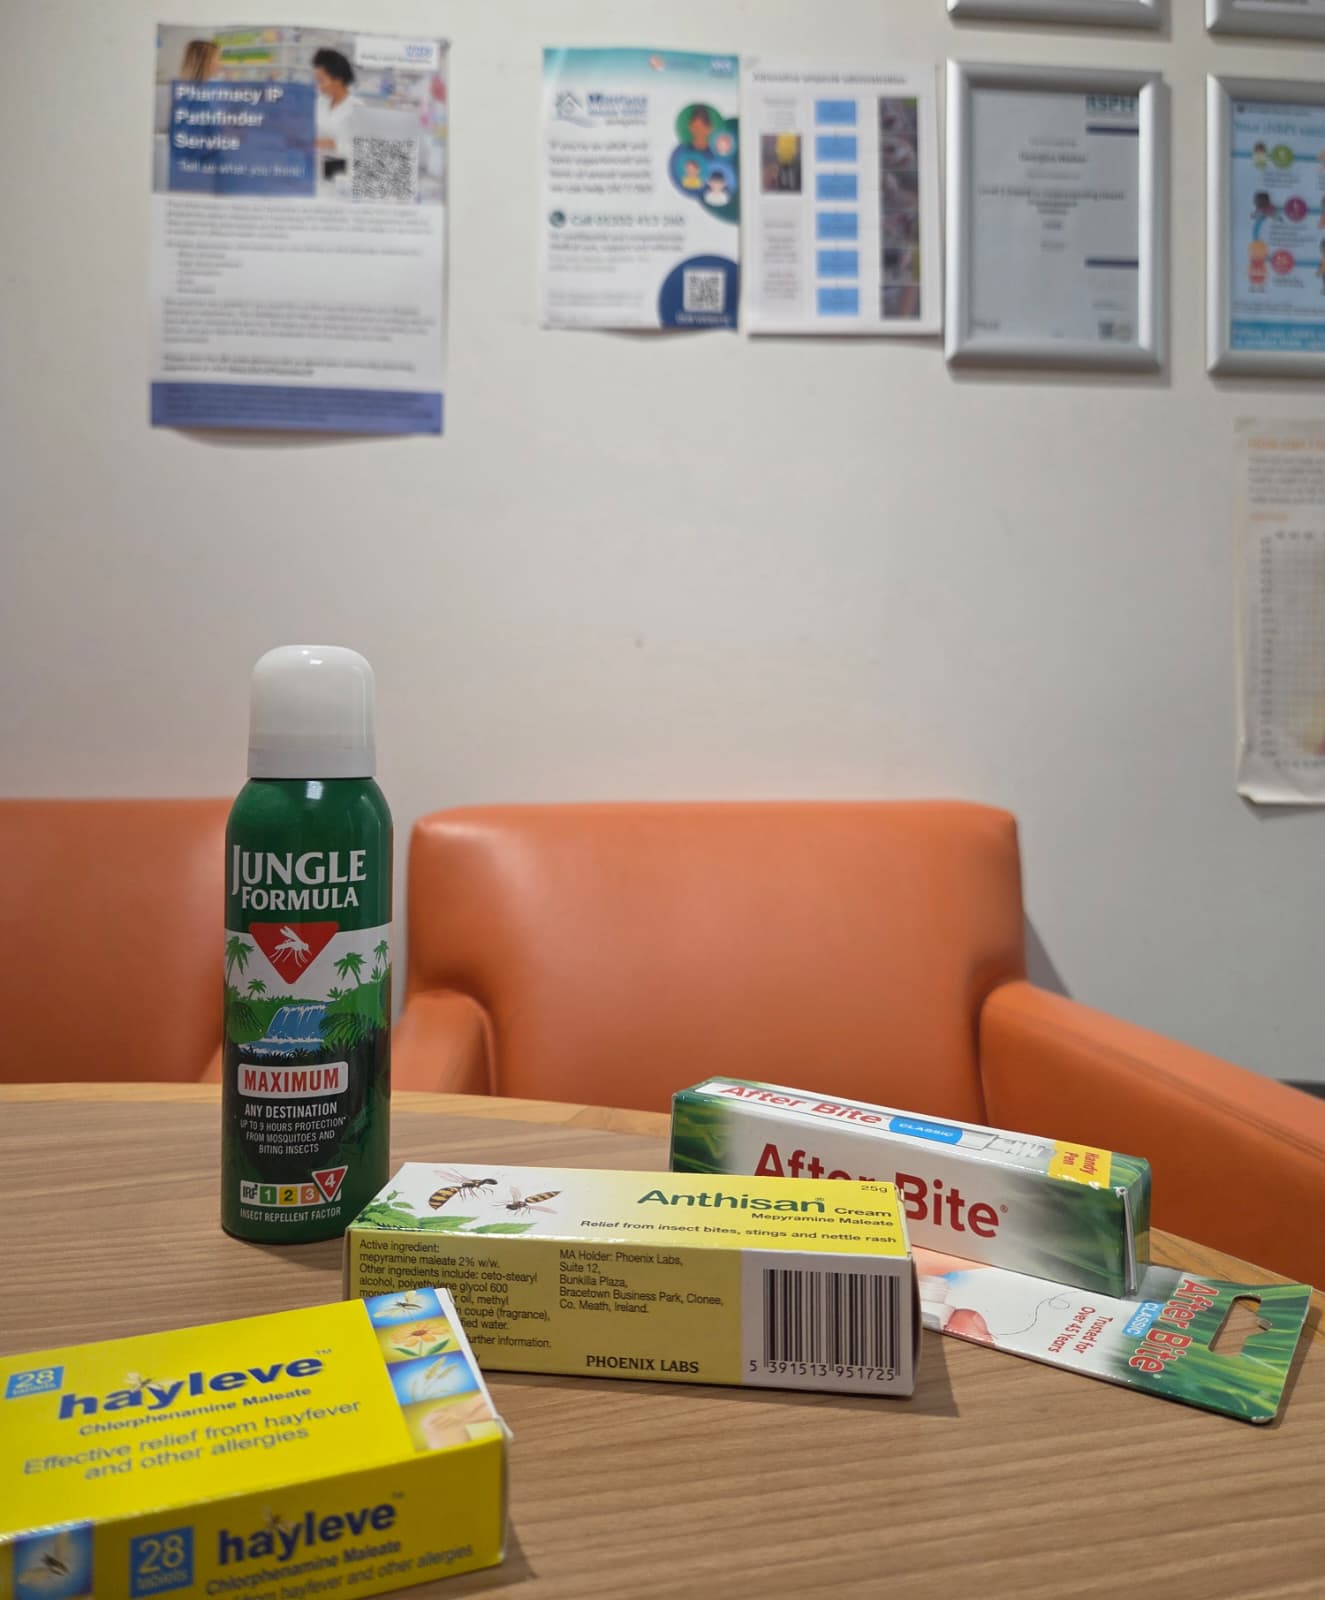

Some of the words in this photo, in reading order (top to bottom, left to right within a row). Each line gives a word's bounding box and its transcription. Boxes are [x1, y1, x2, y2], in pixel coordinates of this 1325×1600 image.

[176, 86, 261, 105] Pharmacy
[175, 109, 263, 127] Pathfinder
[174, 133, 241, 150] Service
[232, 845, 367, 895] JUNGLE
[242, 886, 359, 911] FORMULA
[244, 1067, 339, 1093] MAXIMUM
[245, 1103, 263, 1117] ANY
[266, 1102, 337, 1119] DESTINATION
[721, 1086, 807, 1107] After
[811, 1103, 883, 1124] Bite
[240, 1119, 249, 1129] UP
[250, 1121, 258, 1130] TO
[260, 1121, 265, 1131] 9
[266, 1121, 293, 1132] HOURS
[899, 1123, 955, 1137] CLASSIC
[246, 1132, 265, 1142] FROM
[266, 1131, 317, 1143] MOSQUITOES
[319, 1130, 335, 1140] AND
[259, 1144, 284, 1155] BITING
[285, 1143, 319, 1154] INSECTS
[264, 1190, 271, 1201] 1
[284, 1189, 294, 1201] 2
[305, 1189, 315, 1200] 3
[325, 1173, 337, 1188] 4
[861, 1185, 889, 1194] 25g
[240, 1207, 263, 1221] INSECT
[264, 1209, 309, 1223] REPELLENT
[311, 1206, 341, 1221] FACTOR
[751, 1212, 835, 1225] Mepyramine
[839, 1217, 894, 1227] Maleate
[834, 1207, 892, 1218] Cream
[581, 1220, 620, 1229] Relief
[622, 1222, 655, 1231] from
[658, 1224, 700, 1233] insect
[703, 1226, 741, 1235] bites,
[745, 1228, 787, 1239] stings
[790, 1231, 817, 1240] and
[821, 1233, 861, 1242] nettle
[865, 1235, 897, 1244] rash
[360, 1239, 388, 1250] Active
[390, 1240, 440, 1253] ingredient:
[360, 1253, 417, 1265] mepyramine
[419, 1255, 456, 1266] maleate
[458, 1256, 475, 1267] 2%
[560, 1250, 576, 1260] MA
[579, 1250, 614, 1262] Holder:
[615, 1251, 653, 1264] Phoenix
[656, 1254, 684, 1266] Labs,
[360, 1262, 385, 1274] Other
[388, 1264, 439, 1277] ingredients
[442, 1268, 478, 1280] include:
[481, 1271, 538, 1284] ceto-stearyl
[560, 1261, 584, 1273] Suite
[587, 1263, 601, 1274] 12,
[360, 1276, 395, 1288] alcohol,
[459, 1282, 488, 1293] glycol
[490, 1282, 508, 1294] 600
[560, 1274, 597, 1286] Bunkilla
[599, 1276, 628, 1288] Plaza,
[477, 1295, 509, 1307] methyl
[560, 1286, 610, 1299] Bracetown
[613, 1289, 657, 1301] Business
[659, 1291, 684, 1304] Park,
[686, 1293, 724, 1306] Clonee,
[1157, 1279, 1220, 1329] After
[496, 1308, 551, 1322] (fragrance),
[560, 1299, 576, 1310] Co.
[579, 1300, 612, 1312] Meath,
[614, 1302, 649, 1314] Ireland.
[1073, 1306, 1096, 1325] Over
[481, 1320, 510, 1330] water.
[1127, 1302, 1159, 1335] CLASSIC
[1065, 1323, 1082, 1334] 45
[1083, 1315, 1113, 1342] Trusted
[497, 1335, 552, 1348] information.
[1048, 1333, 1074, 1353] Years
[1073, 1341, 1094, 1354] for
[1129, 1327, 1193, 1373] Bite
[586, 1355, 654, 1371] PHOENIX
[660, 1358, 699, 1374] LABS
[750, 1360, 757, 1373] 5
[768, 1361, 827, 1376] 391513
[836, 1365, 895, 1381] 951725
[15, 1369, 55, 1389] 28
[79, 1401, 237, 1436] Chlorphenamine
[242, 1387, 311, 1406] Maleate
[24, 1445, 131, 1475] Effective
[139, 1430, 197, 1452] relief
[205, 1421, 258, 1440] from
[264, 1401, 361, 1429] hayfever
[84, 1458, 132, 1480] and
[140, 1447, 204, 1470] other
[211, 1428, 310, 1456] allergies
[138, 1534, 185, 1574] 28
[206, 1555, 338, 1596] Chlorphenamine
[343, 1541, 401, 1563] Maleate
[347, 1567, 373, 1585] and
[378, 1559, 412, 1578] other
[417, 1545, 473, 1568] allergies
